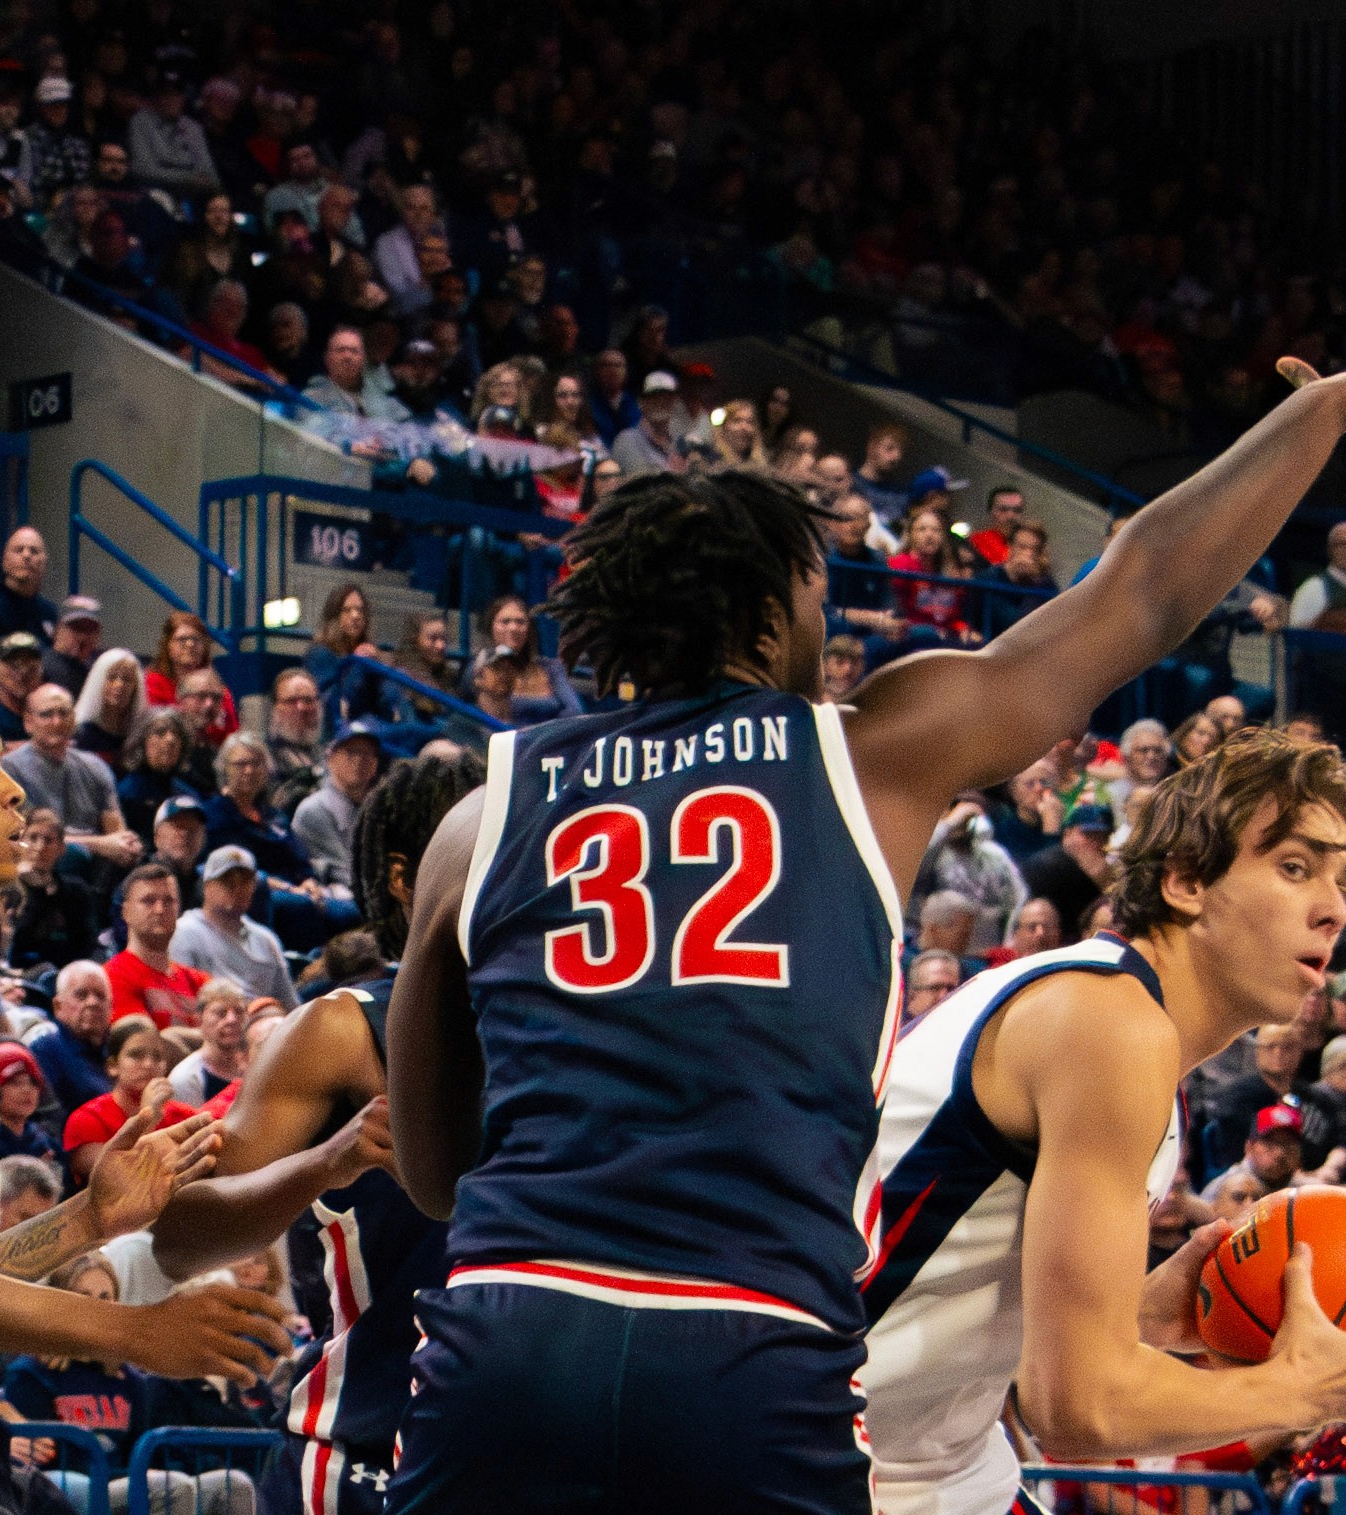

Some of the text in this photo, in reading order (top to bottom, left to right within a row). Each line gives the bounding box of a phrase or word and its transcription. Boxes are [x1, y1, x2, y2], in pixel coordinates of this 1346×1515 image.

[311, 525, 360, 561] 106
[583, 716, 788, 788] JOHNSON
[544, 785, 791, 995] 32
